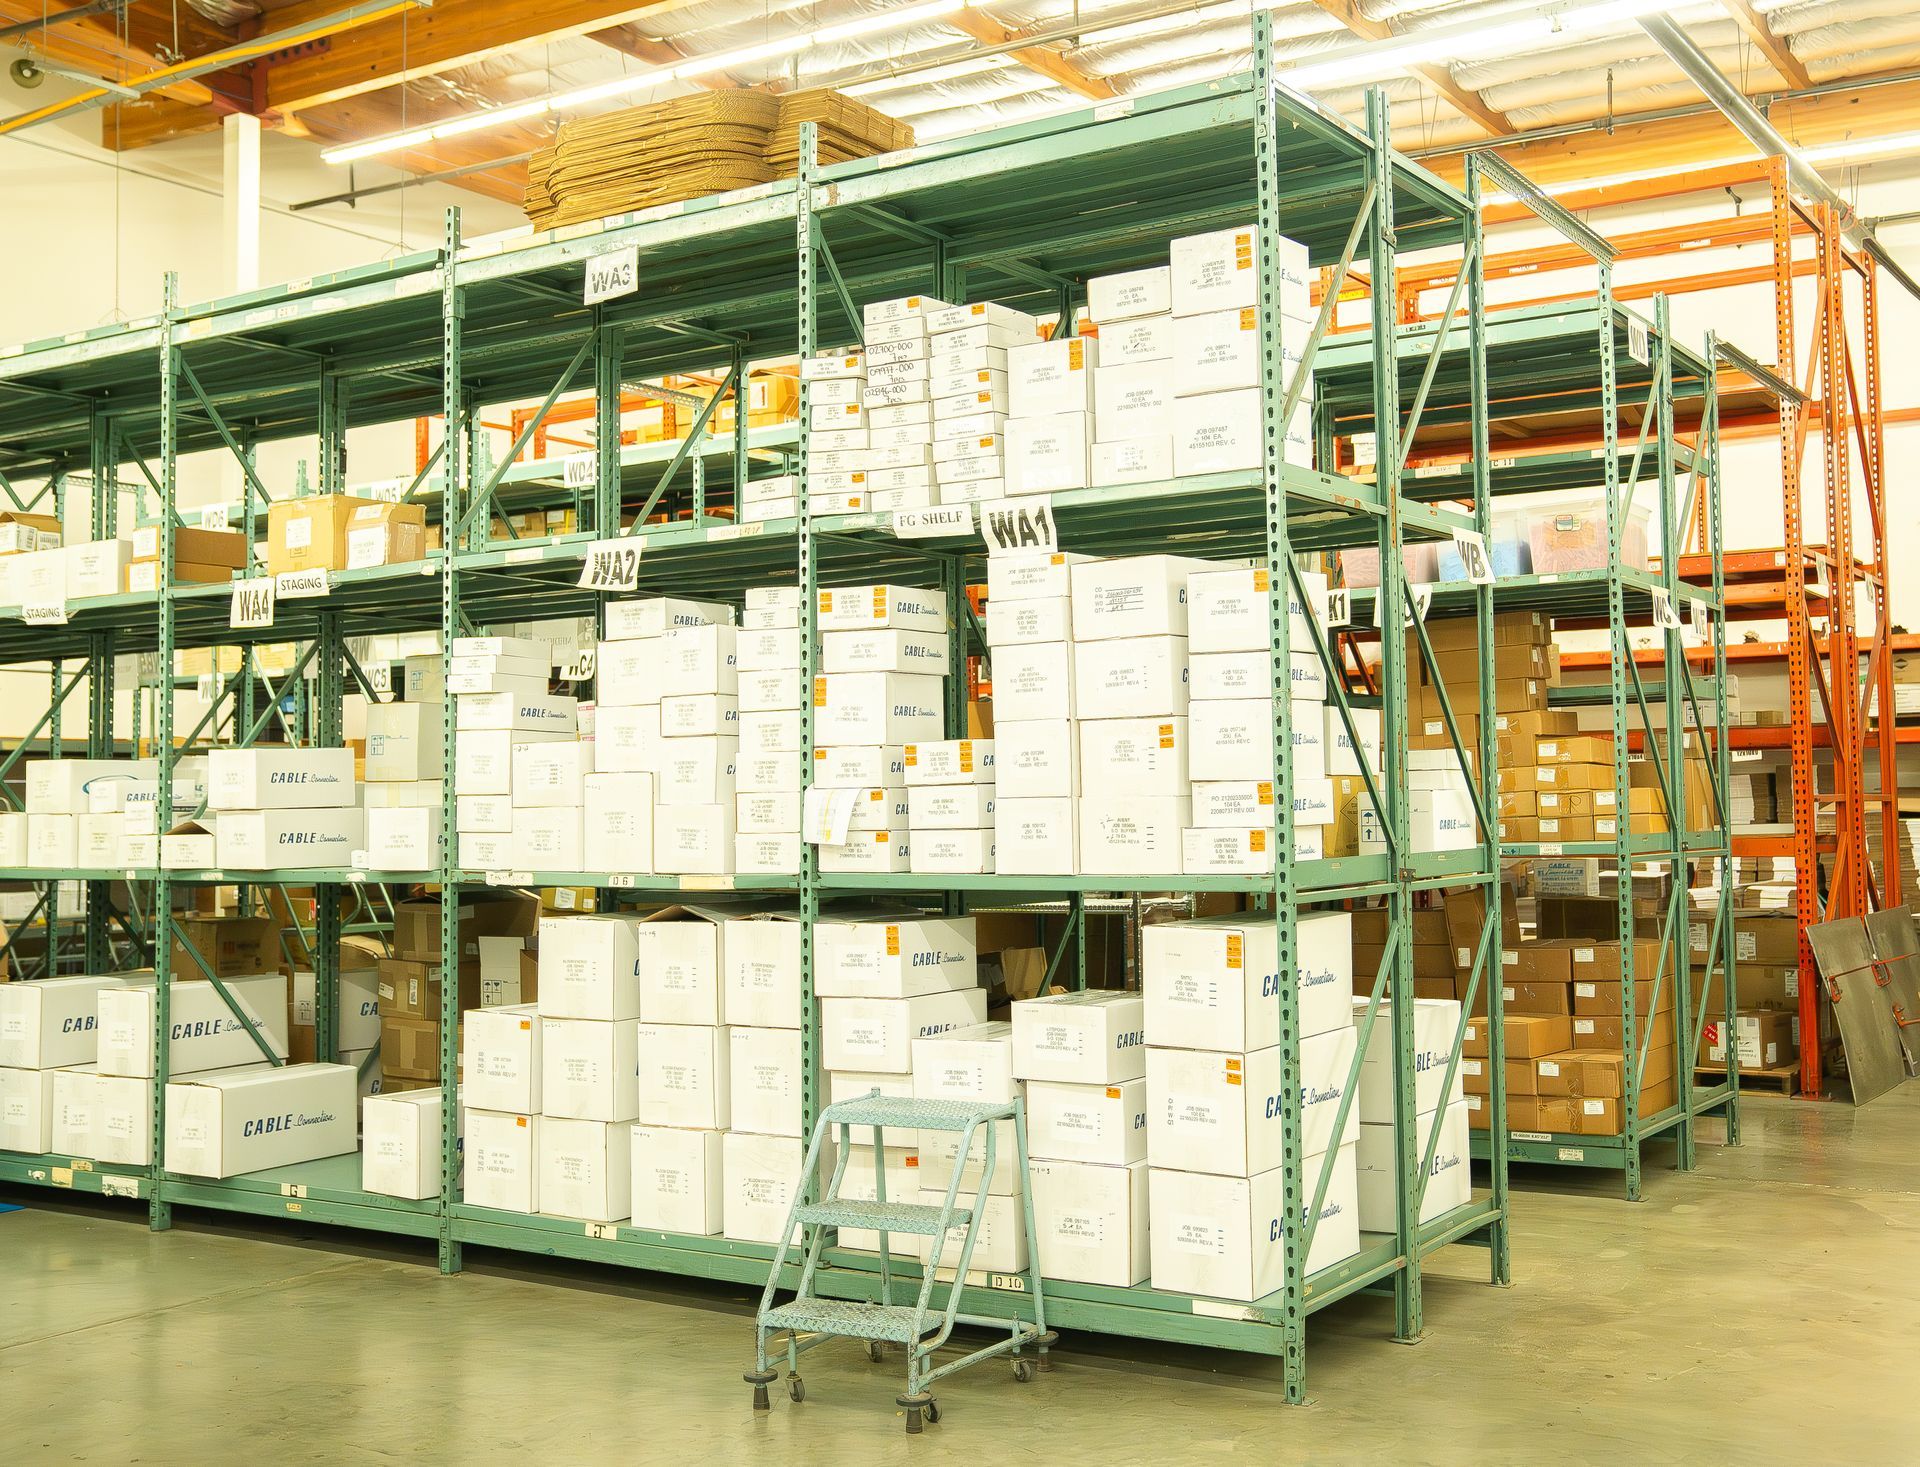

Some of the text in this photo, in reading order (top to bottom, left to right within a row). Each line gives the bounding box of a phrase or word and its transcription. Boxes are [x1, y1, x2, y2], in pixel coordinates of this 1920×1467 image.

[592, 264, 631, 294] WA3
[899, 510, 963, 527] FG SHELF
[989, 506, 1051, 549] WA1
[1457, 539, 1487, 579] WB
[591, 548, 636, 586] WA2
[280, 577, 322, 592] STAGING
[239, 588, 270, 621] WA4
[897, 601, 919, 615] CABLE
[1328, 592, 1346, 622] K1
[26, 607, 61, 620] STAGING
[673, 614, 700, 626] CABLE
[905, 645, 925, 658] CABLE
[520, 707, 546, 719] CABLE
[893, 705, 917, 717] CABLE
[270, 772, 307, 784] CABLE
[1439, 819, 1456, 830] CABLE
[279, 832, 316, 845] CABLE
[912, 951, 942, 967] CABLE
[171, 1017, 222, 1041] CABLE
[243, 1108, 336, 1138] CABLE Connection
[290, 1184, 298, 1197] G
[593, 1224, 607, 1238] J
[995, 1276, 1021, 1288] D 10
